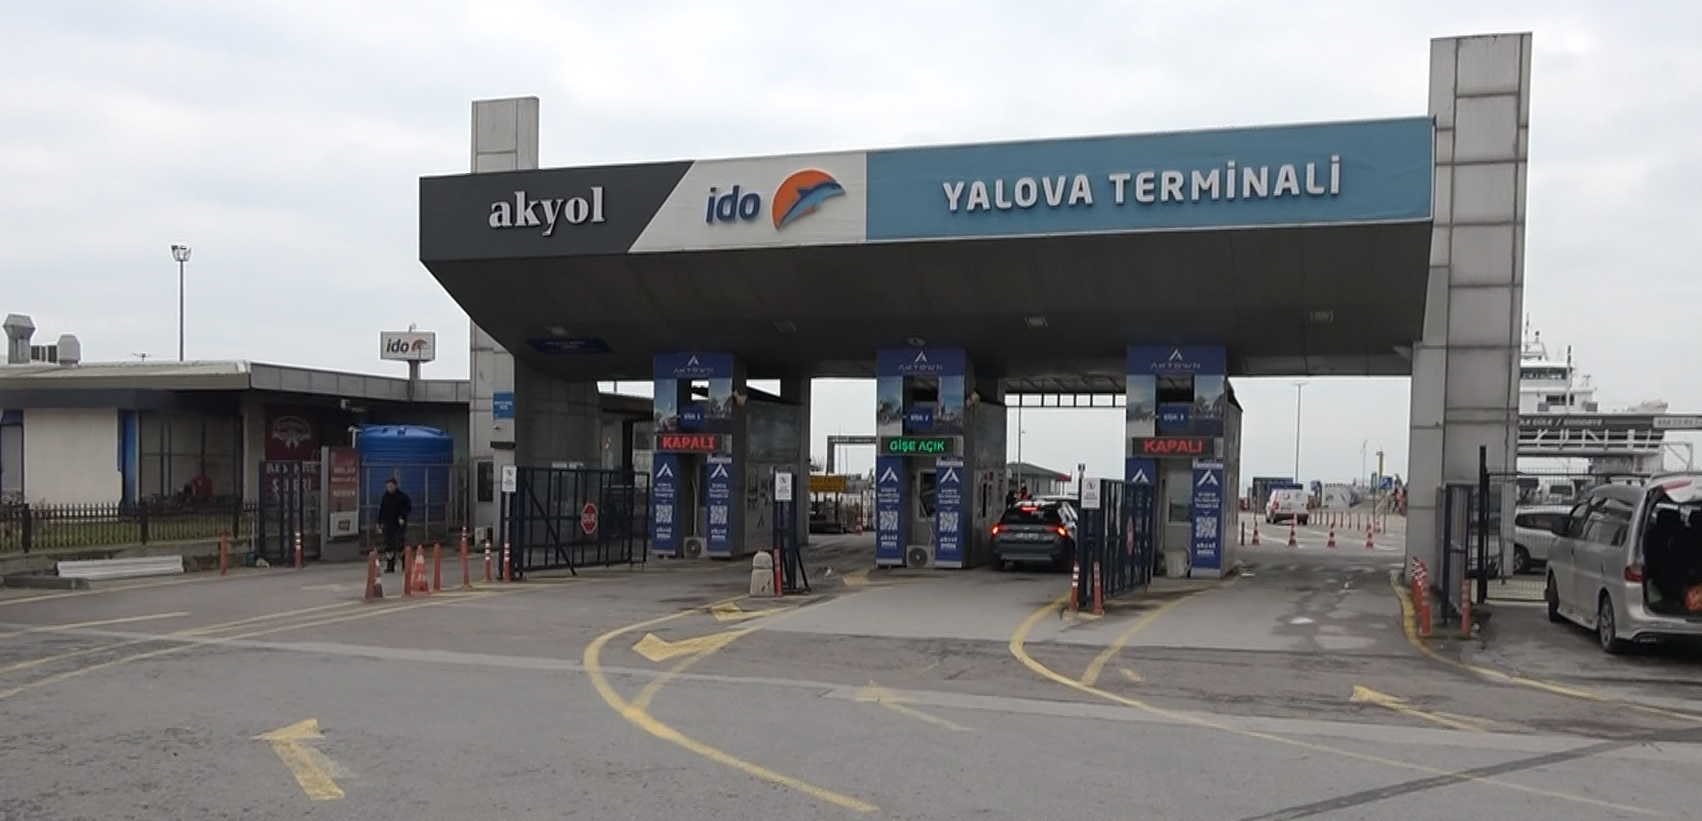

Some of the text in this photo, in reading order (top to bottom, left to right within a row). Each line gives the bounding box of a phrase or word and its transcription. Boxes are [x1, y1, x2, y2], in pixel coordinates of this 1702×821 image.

[942, 155, 1341, 211] YALOVA TERMİNALİ
[488, 186, 605, 237] akyol
[706, 185, 761, 224] ido
[386, 338, 409, 353] ido
[662, 435, 715, 449] KAPALI
[890, 438, 916, 452] GİŞE
[918, 440, 945, 453] AÇIK
[1144, 439, 1203, 453] KAPALI
